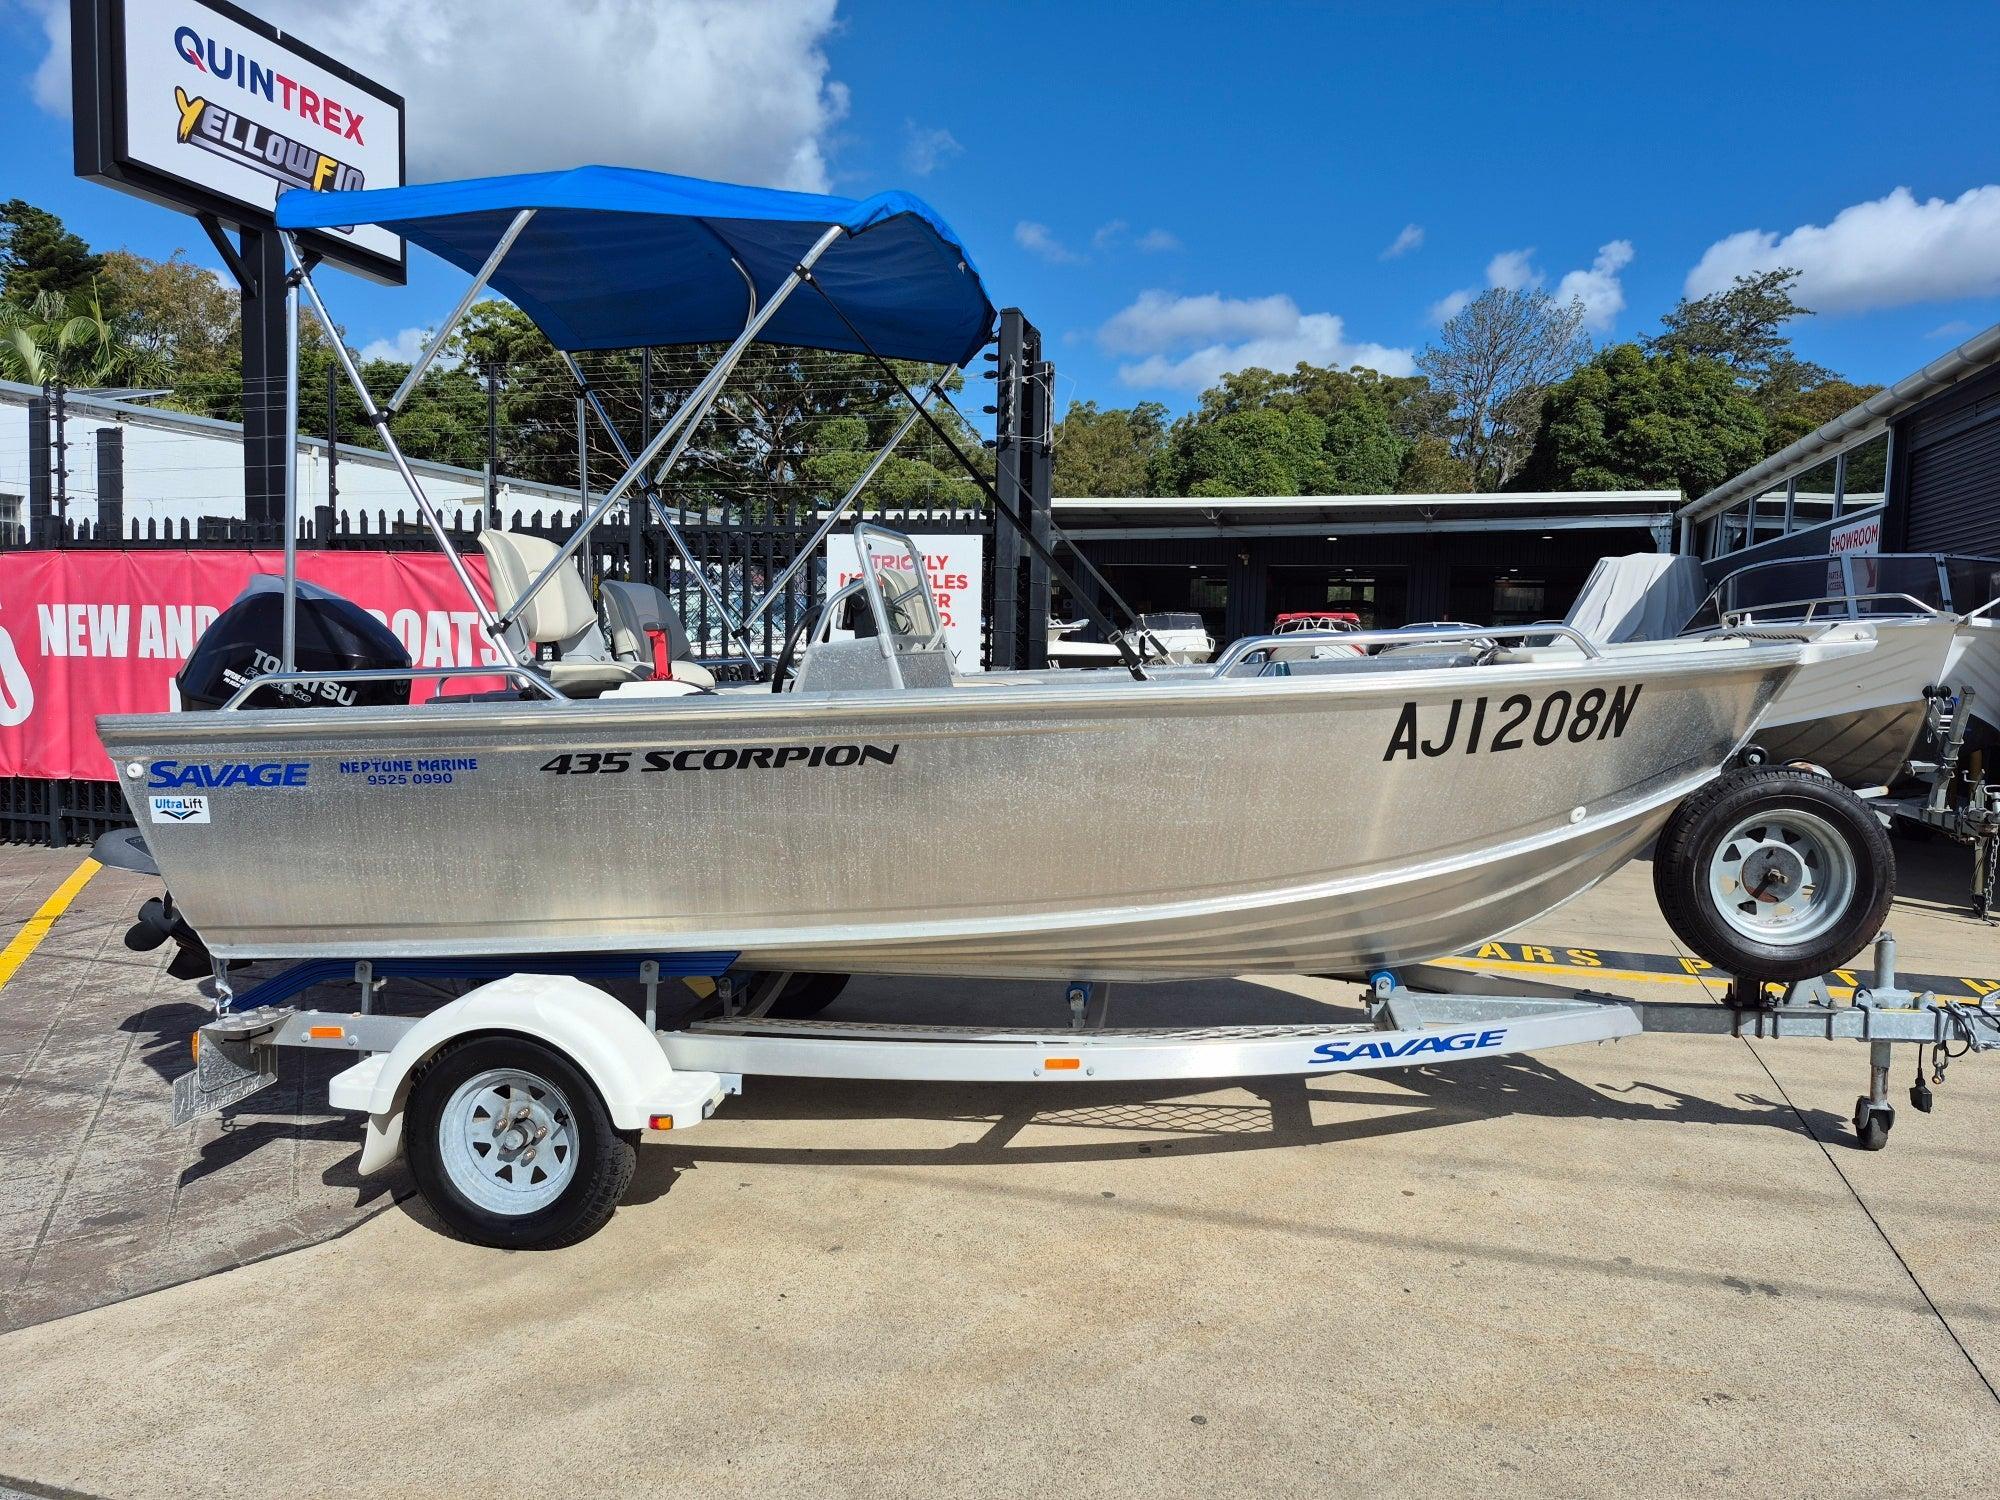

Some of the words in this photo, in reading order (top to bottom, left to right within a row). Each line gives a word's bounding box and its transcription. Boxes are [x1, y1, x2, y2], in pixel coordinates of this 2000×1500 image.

[174, 26, 365, 146] QUINTREX
[1830, 523, 1879, 554] SHOWROOM
[860, 554, 949, 571] TRICLY
[37, 603, 130, 658] NEW
[364, 608, 509, 668] OATS
[1382, 683, 1643, 761] AJ1208N
[148, 760, 310, 788] SAVAGE
[340, 758, 413, 773] NEPTUNE
[418, 758, 478, 771] MARINE
[539, 752, 633, 775] 435
[640, 744, 900, 772] SCORPION
[367, 774, 407, 785] 9525
[412, 773, 453, 785] 0990
[155, 798, 203, 809] UltraLift
[1477, 943, 1602, 967] ARS
[1307, 1028, 1508, 1064] SAVAGE
